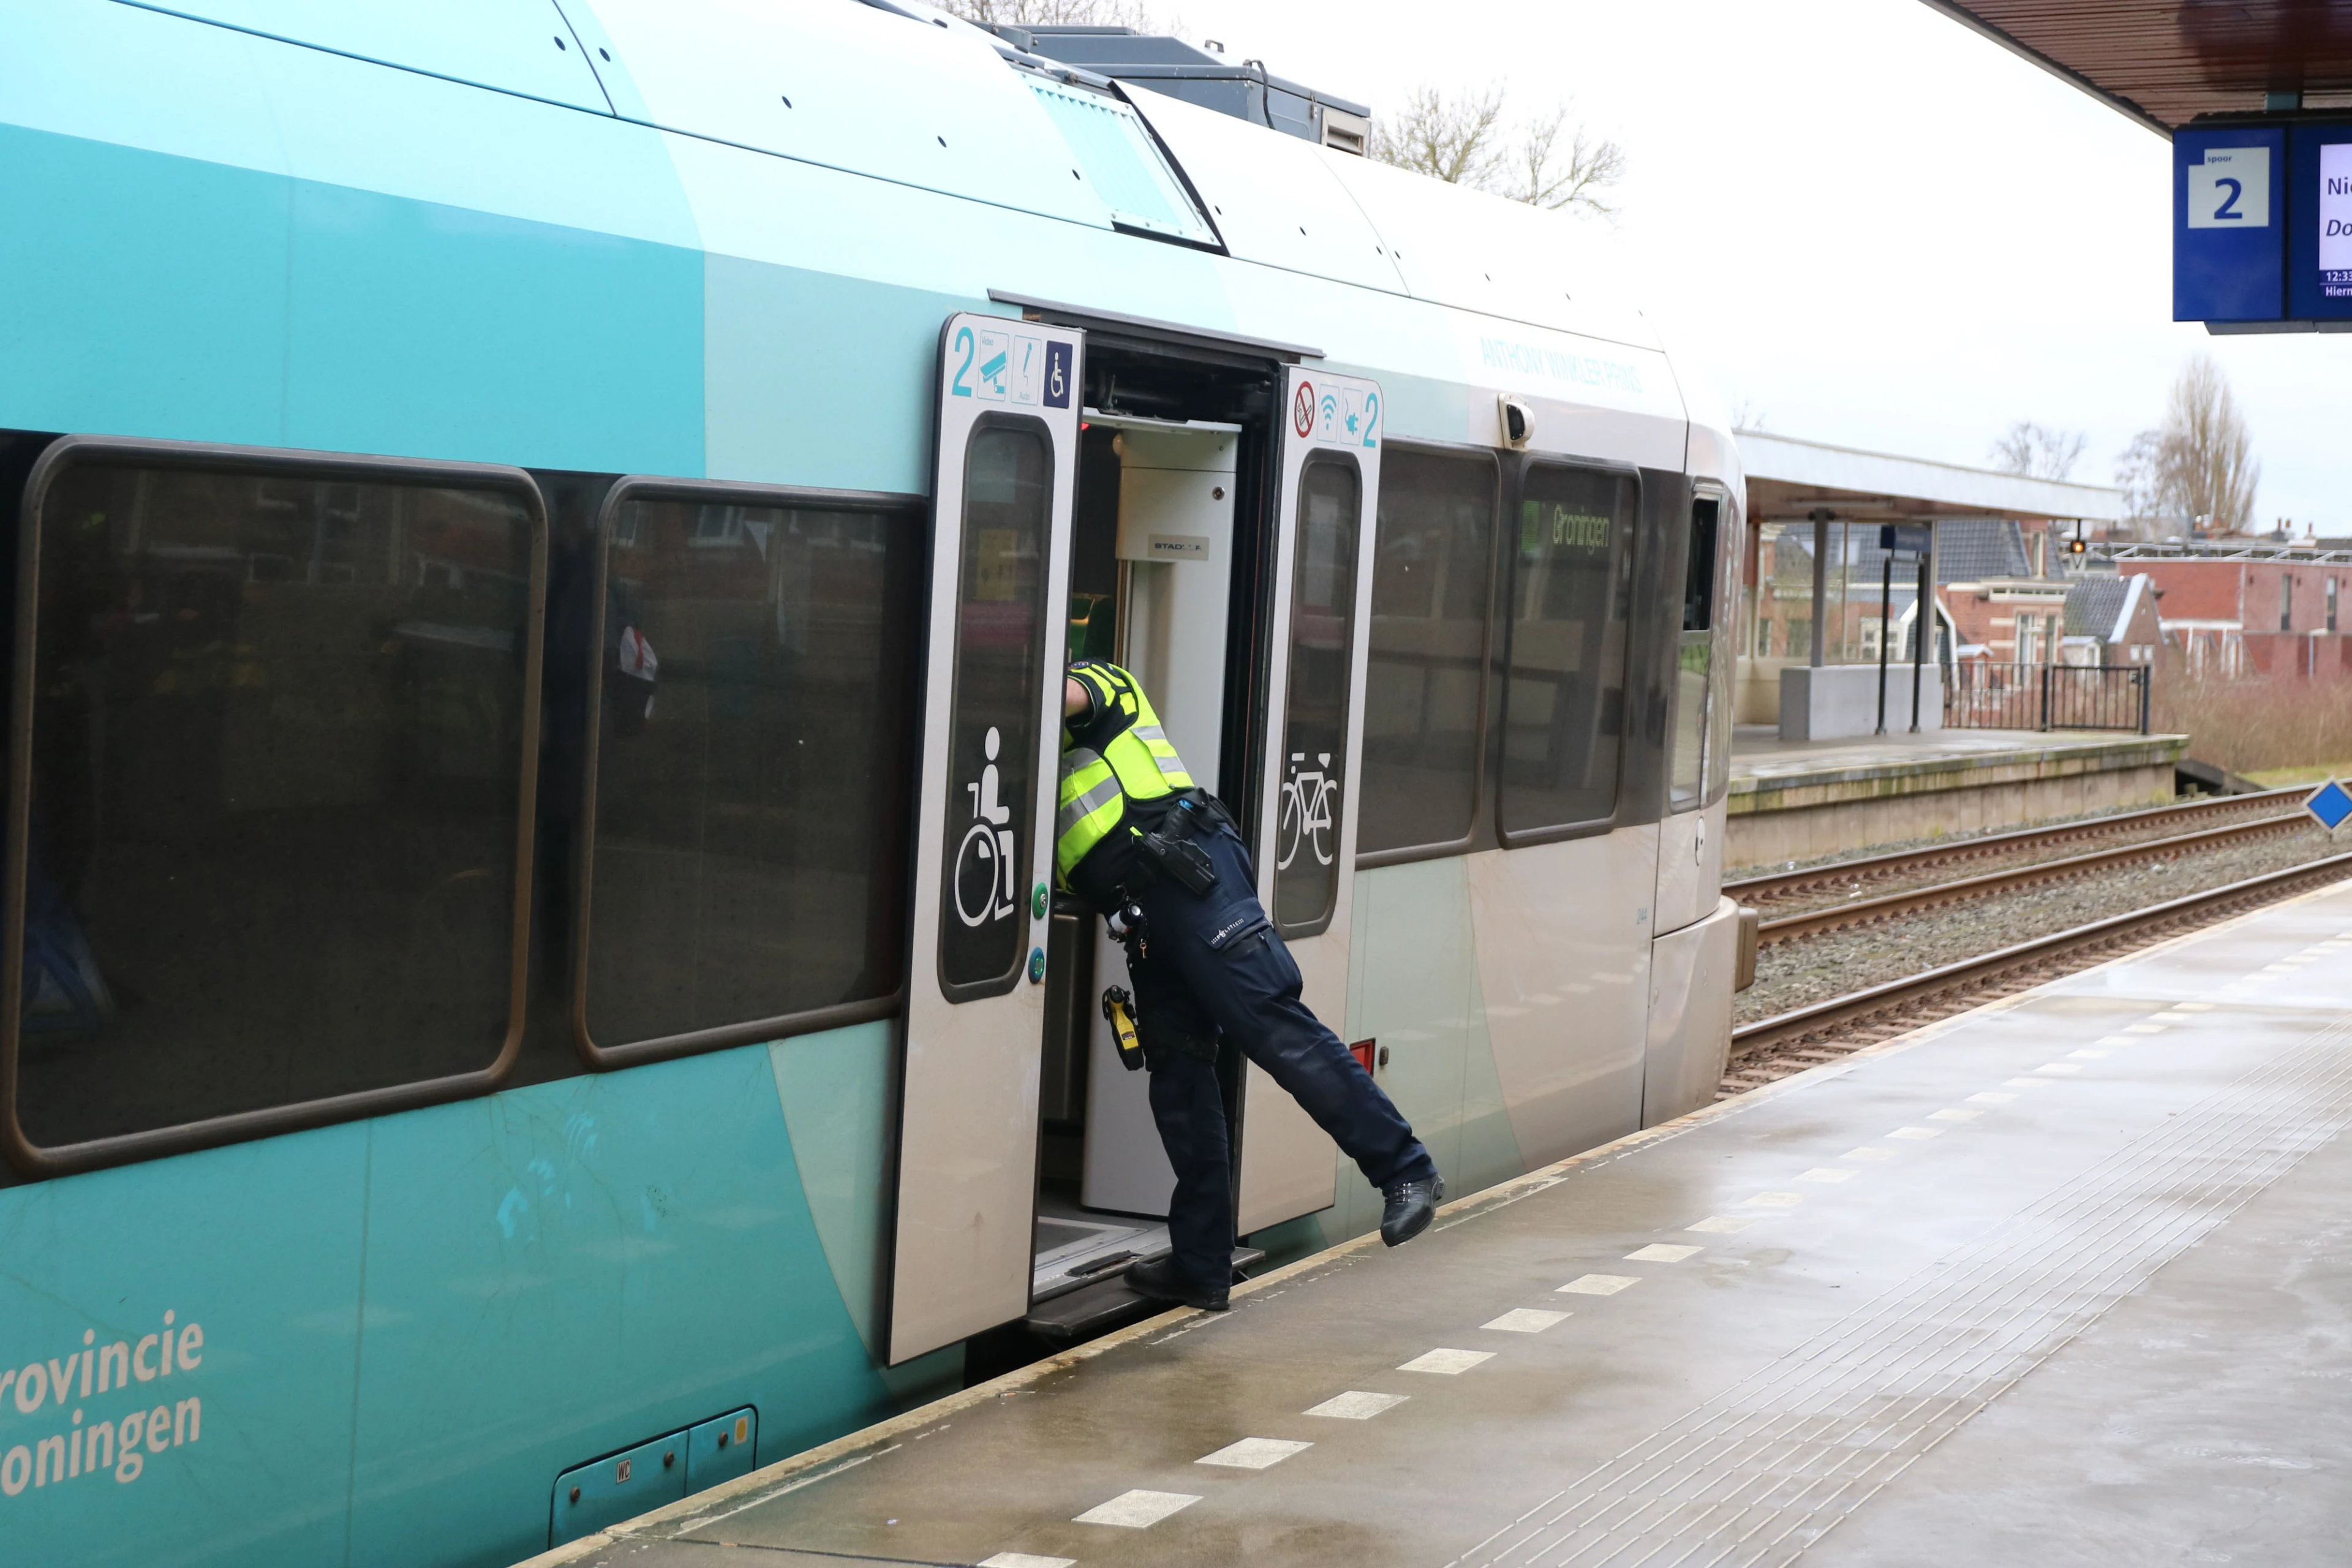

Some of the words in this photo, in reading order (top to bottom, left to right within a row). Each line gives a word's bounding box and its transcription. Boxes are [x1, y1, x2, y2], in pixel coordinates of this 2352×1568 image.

[2214, 178, 2242, 219] 2
[2328, 177, 2352, 195] Ni
[952, 326, 975, 397] 2
[981, 336, 994, 346] Video
[1479, 336, 1545, 376] ANTHONY
[1545, 350, 1603, 387] WINKLER
[1604, 361, 1644, 393] PRINS
[1019, 391, 1031, 401] Audio
[1363, 392, 1378, 448] 2
[1553, 503, 1610, 556] Groningen
[617, 1461, 630, 1481] WC
